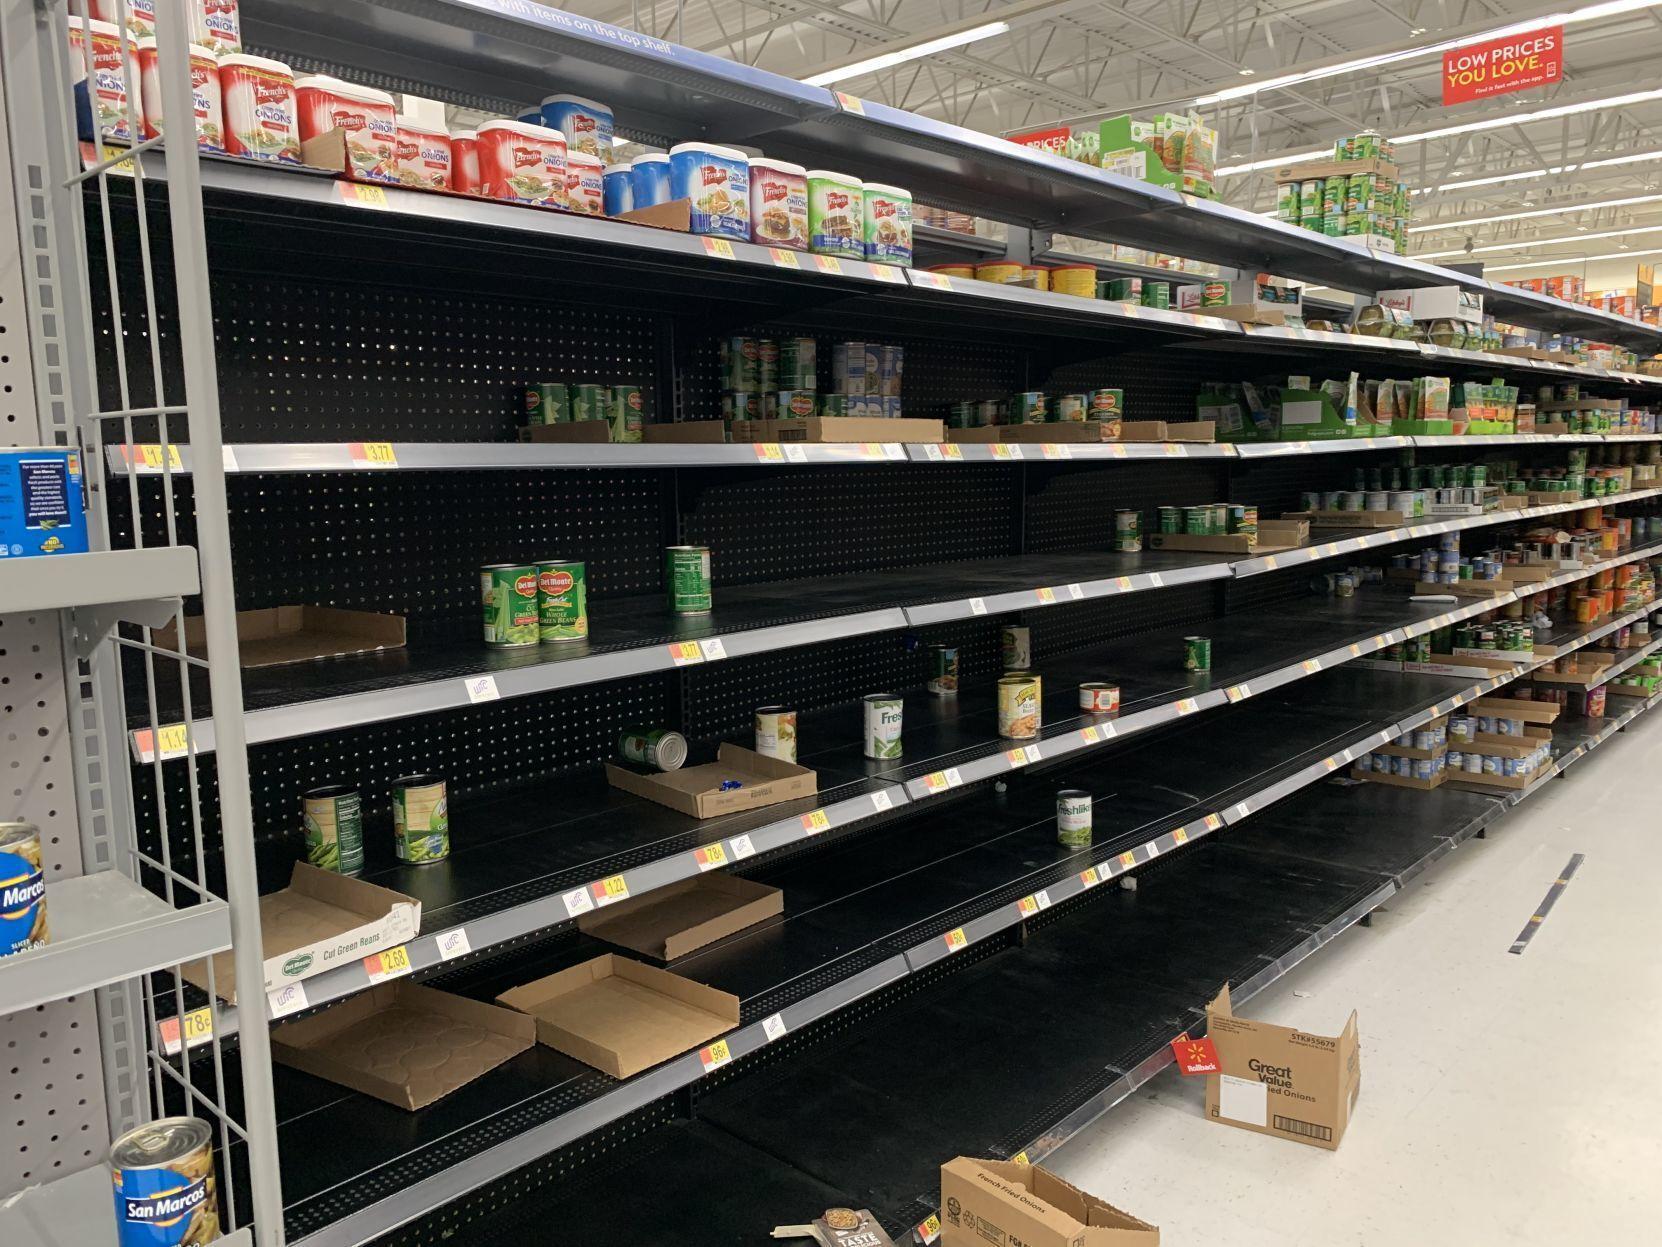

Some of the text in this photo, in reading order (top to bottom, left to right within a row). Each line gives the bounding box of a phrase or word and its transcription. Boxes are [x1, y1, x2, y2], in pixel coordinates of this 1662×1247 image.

[533, 8, 572, 26] items
[575, 20, 592, 32] on
[593, 24, 616, 39] the
[618, 31, 640, 47] top
[643, 39, 676, 56] shelf.
[1448, 35, 1555, 73] LOW PRICES
[1447, 55, 1543, 88] YOU LOVE.
[1475, 86, 1488, 95] Find
[255, 108, 292, 125] ONIONS
[421, 151, 449, 163] ONIONS
[540, 577, 571, 586] Del Monte
[3, 879, 44, 908] Marcos
[324, 933, 380, 961] Cut Green Beans
[1291, 1033, 1336, 1048] STK#55679
[1187, 1063, 1217, 1072] Rollback
[1248, 1058, 1292, 1080] Great
[1258, 1073, 1293, 1089] Value
[1284, 1089, 1317, 1103] Onions
[977, 1172, 1046, 1214] French Fried Onions
[128, 1186, 205, 1218] San Marcos
[838, 1231, 880, 1247] TASTE
